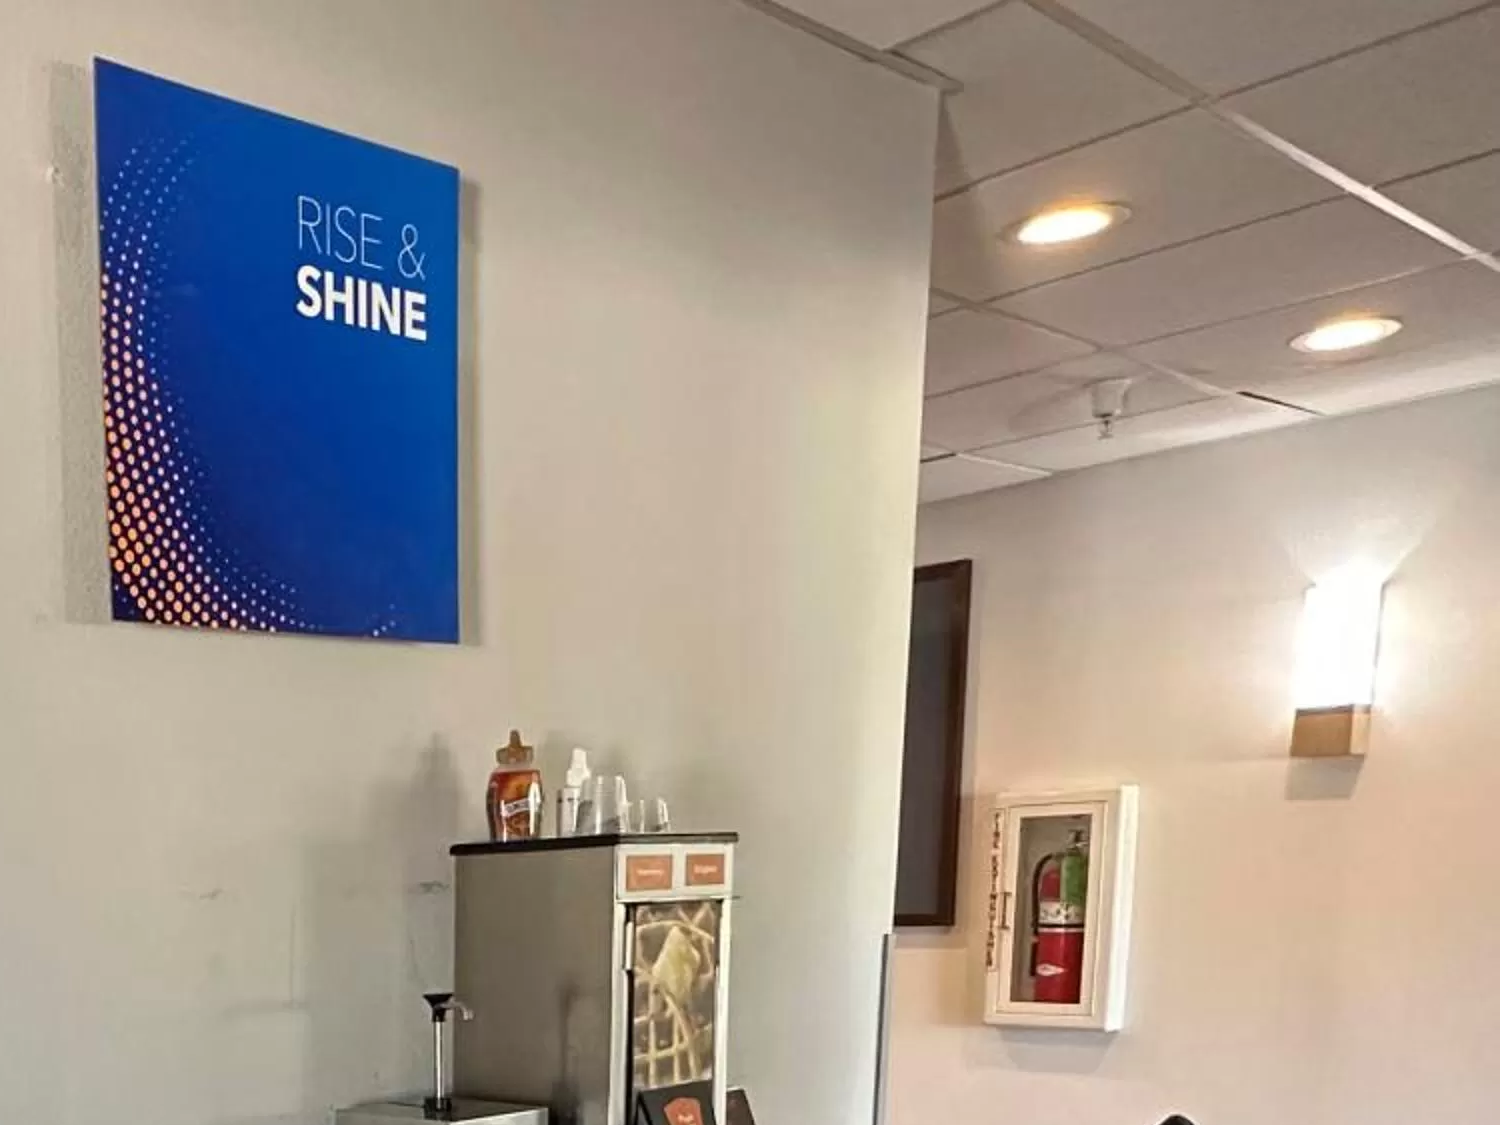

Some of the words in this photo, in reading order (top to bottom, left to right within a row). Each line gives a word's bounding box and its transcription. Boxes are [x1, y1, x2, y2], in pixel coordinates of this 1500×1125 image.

[297, 195, 384, 270] RISE
[398, 223, 426, 280] &
[296, 264, 427, 341] SHINE
